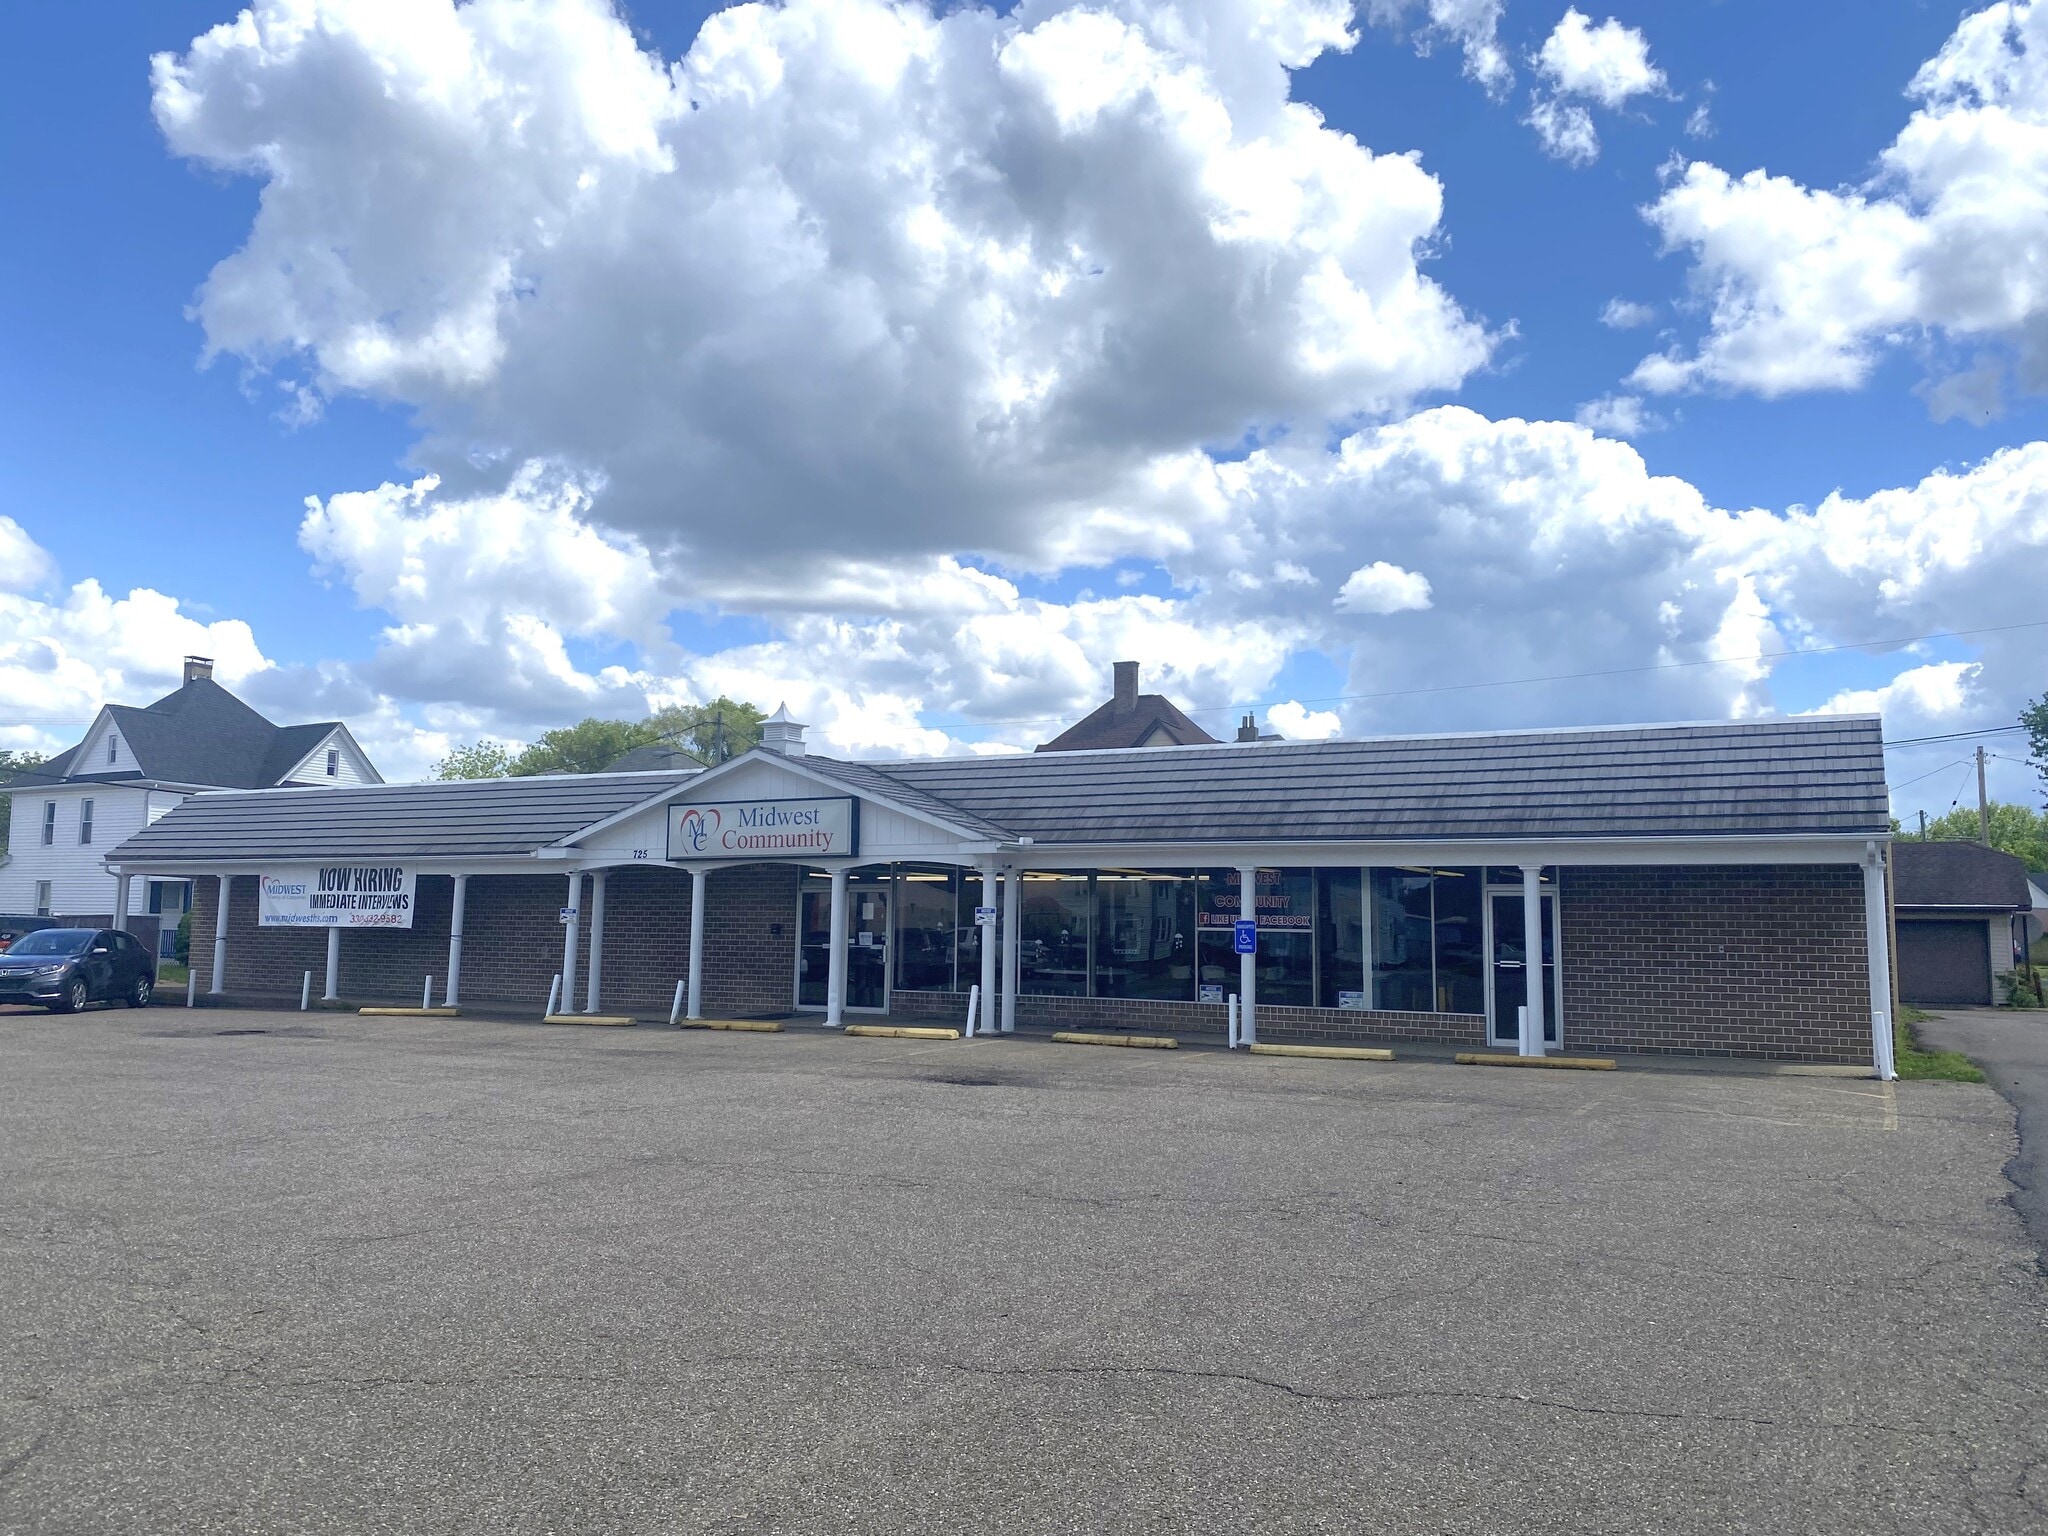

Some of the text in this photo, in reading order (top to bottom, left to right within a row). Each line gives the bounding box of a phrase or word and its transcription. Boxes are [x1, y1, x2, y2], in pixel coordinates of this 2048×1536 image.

[739, 807, 820, 828] Midwest
[722, 829, 834, 852] Community
[633, 850, 648, 859] 725
[318, 868, 403, 892] NOW HIRING
[267, 885, 306, 895] MIDWEST
[309, 894, 409, 910] IMMEDIATE INTERVIEWS
[1211, 914, 1229, 924] LIKE
[1260, 915, 1310, 926] FACEBOOK
